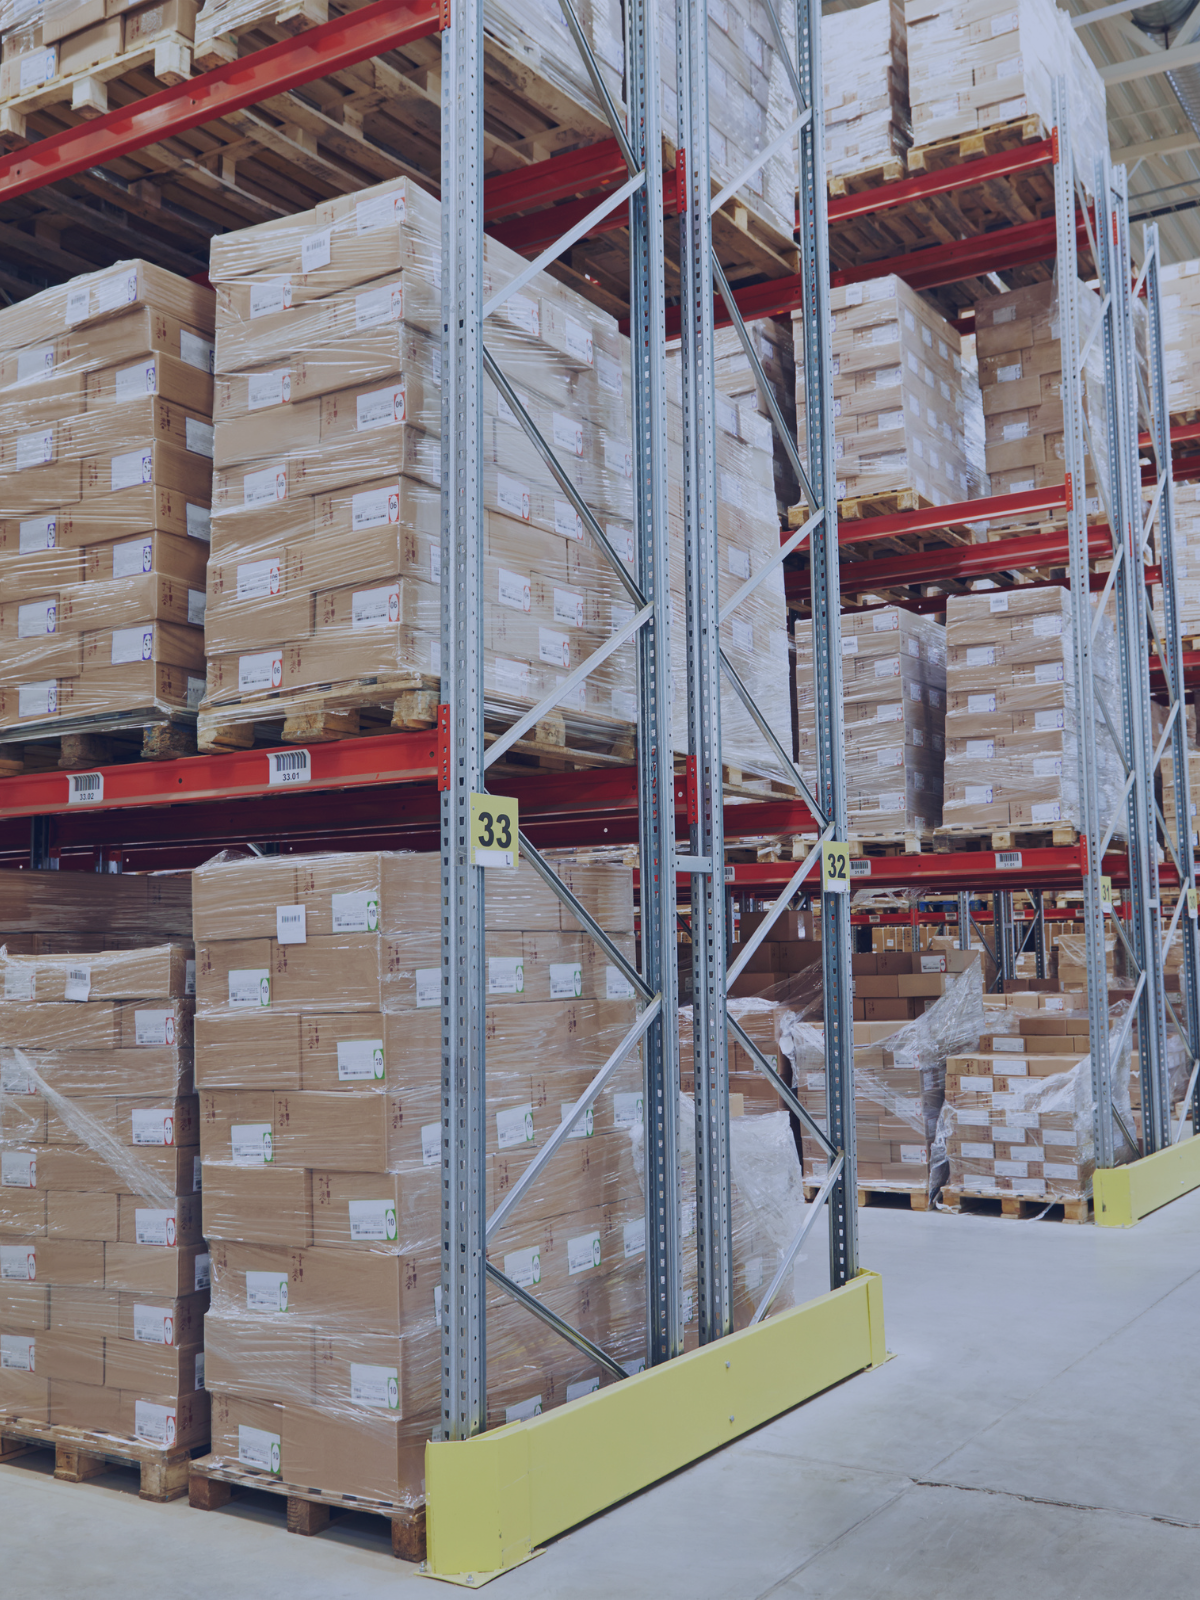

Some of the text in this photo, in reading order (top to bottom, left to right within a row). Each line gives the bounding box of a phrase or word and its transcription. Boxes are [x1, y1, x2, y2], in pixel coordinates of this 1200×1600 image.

[396, 400, 403, 408] 06
[390, 501, 397, 510] 06
[390, 601, 398, 609] 06
[274, 666, 280, 674] 06
[282, 772, 300, 781] 33.01
[80, 793, 94, 801] 33.02
[478, 812, 512, 849] 33
[506, 854, 510, 865] L
[828, 854, 846, 878] 32
[1102, 884, 1110, 900] 31
[369, 910, 376, 918] 10
[262, 986, 268, 994] 10
[168, 1026, 172, 1034] 11
[376, 1058, 382, 1066] 10
[166, 1126, 172, 1134] 11
[388, 1218, 394, 1226] 10
[168, 1228, 174, 1236] 11
[30, 1262, 34, 1270] 11
[282, 1290, 288, 1298] 10
[166, 1326, 172, 1334] 11
[390, 1386, 396, 1395] 10
[168, 1425, 174, 1433] 11
[273, 1452, 279, 1460] 10
